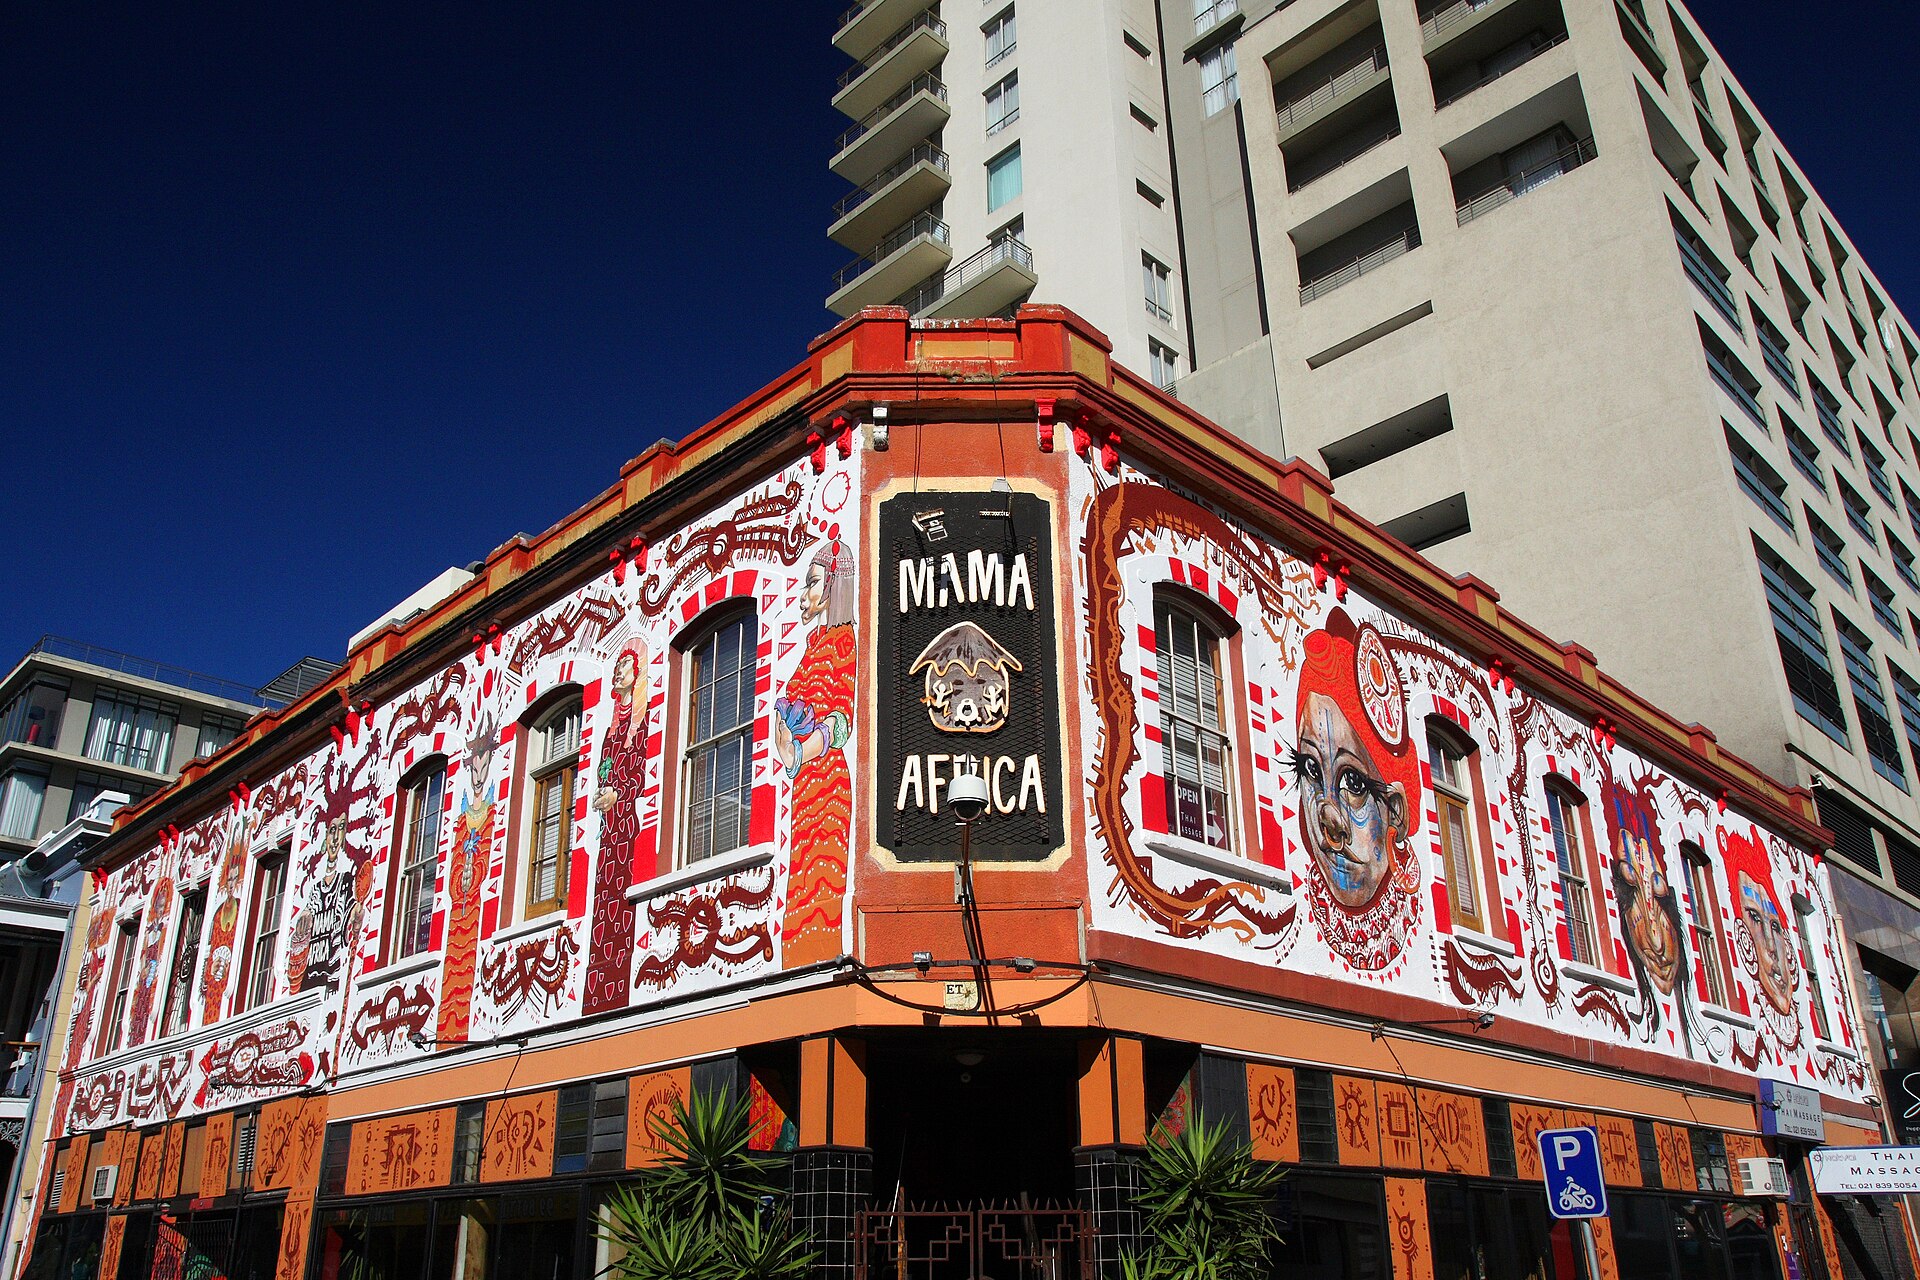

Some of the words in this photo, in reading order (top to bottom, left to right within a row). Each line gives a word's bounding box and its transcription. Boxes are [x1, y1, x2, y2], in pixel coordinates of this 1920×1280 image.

[899, 549, 1034, 613] MAMA
[1181, 811, 1196, 824] THAI
[1181, 825, 1202, 839] ASSAGE
[946, 984, 963, 995] ET
[1793, 1108, 1821, 1123] MASSAGE
[1553, 1136, 1581, 1170] P
[1871, 1152, 1915, 1161] THAI
